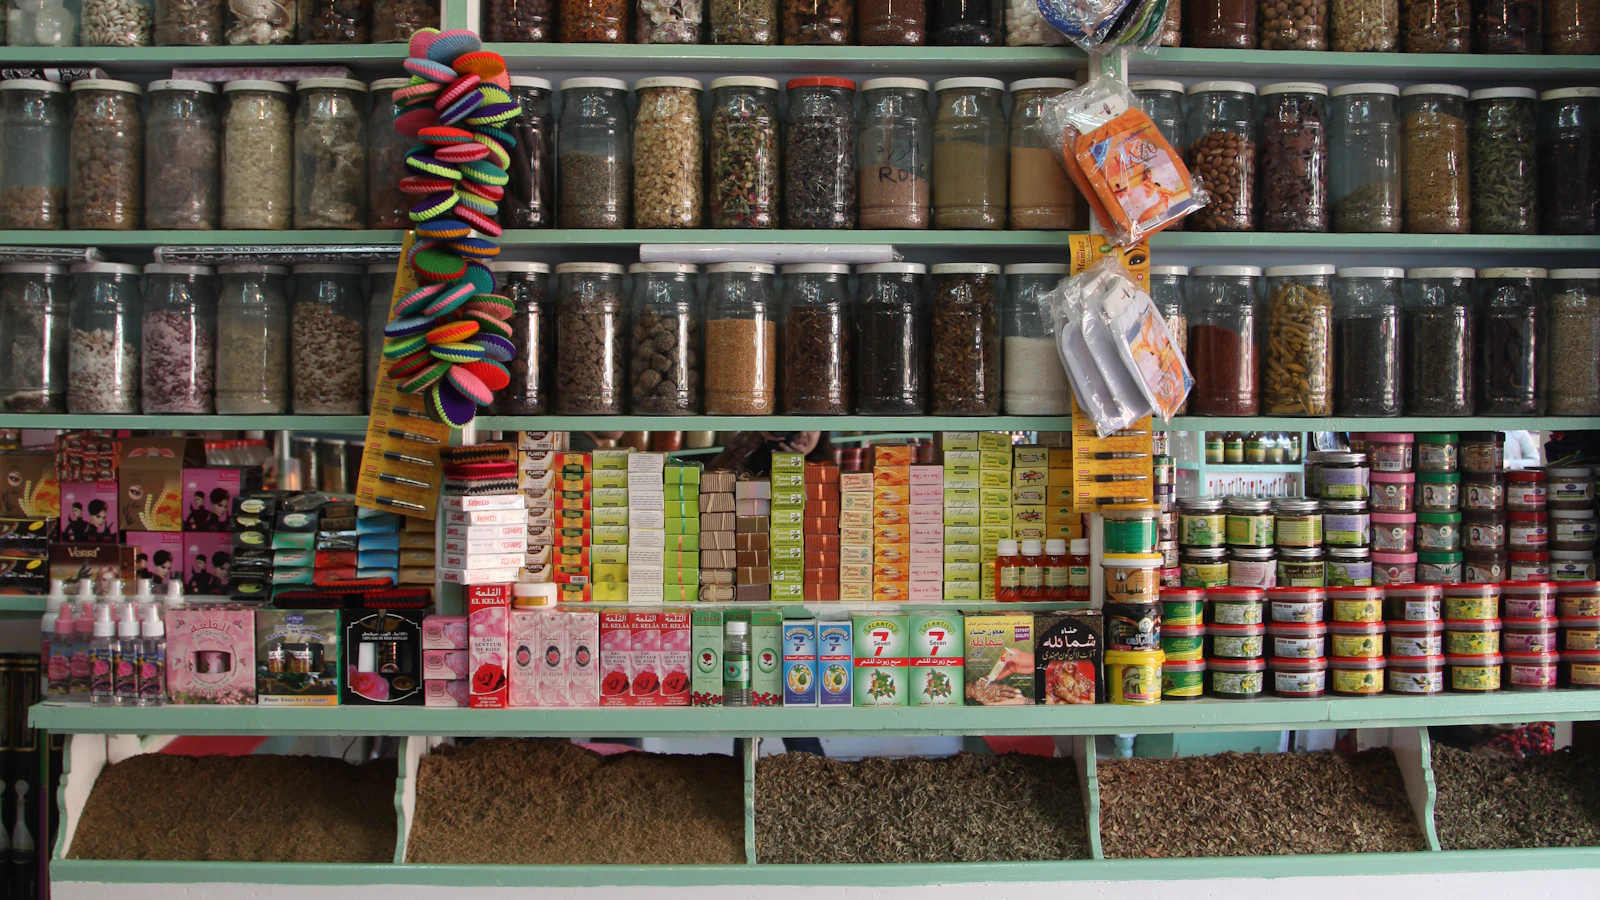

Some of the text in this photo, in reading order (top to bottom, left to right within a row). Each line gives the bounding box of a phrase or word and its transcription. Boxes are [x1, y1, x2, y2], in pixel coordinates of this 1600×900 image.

[475, 587, 501, 597] القلعة
[873, 632, 889, 657] 7
[928, 631, 945, 656] 7
